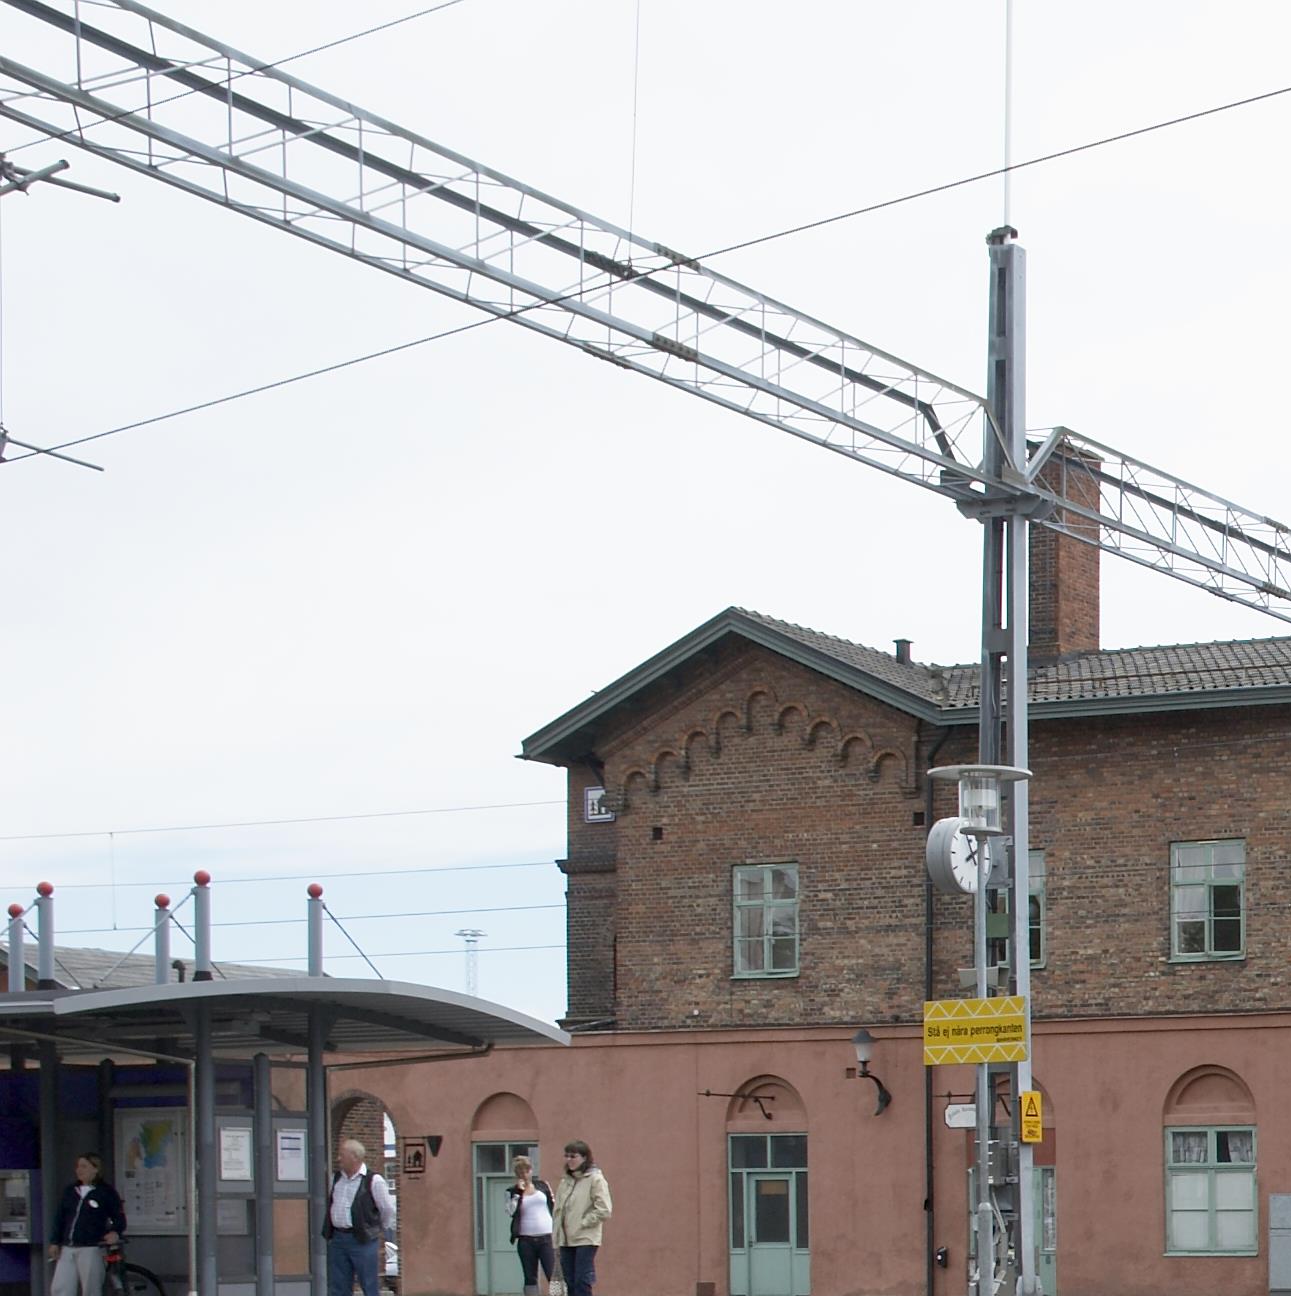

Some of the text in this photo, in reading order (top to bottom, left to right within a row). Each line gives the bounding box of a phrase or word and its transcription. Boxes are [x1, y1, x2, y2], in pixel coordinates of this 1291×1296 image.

[927, 1024, 940, 1038] Stå
[943, 1025, 950, 1038] ej
[970, 1023, 1023, 1038] perrongkanten
